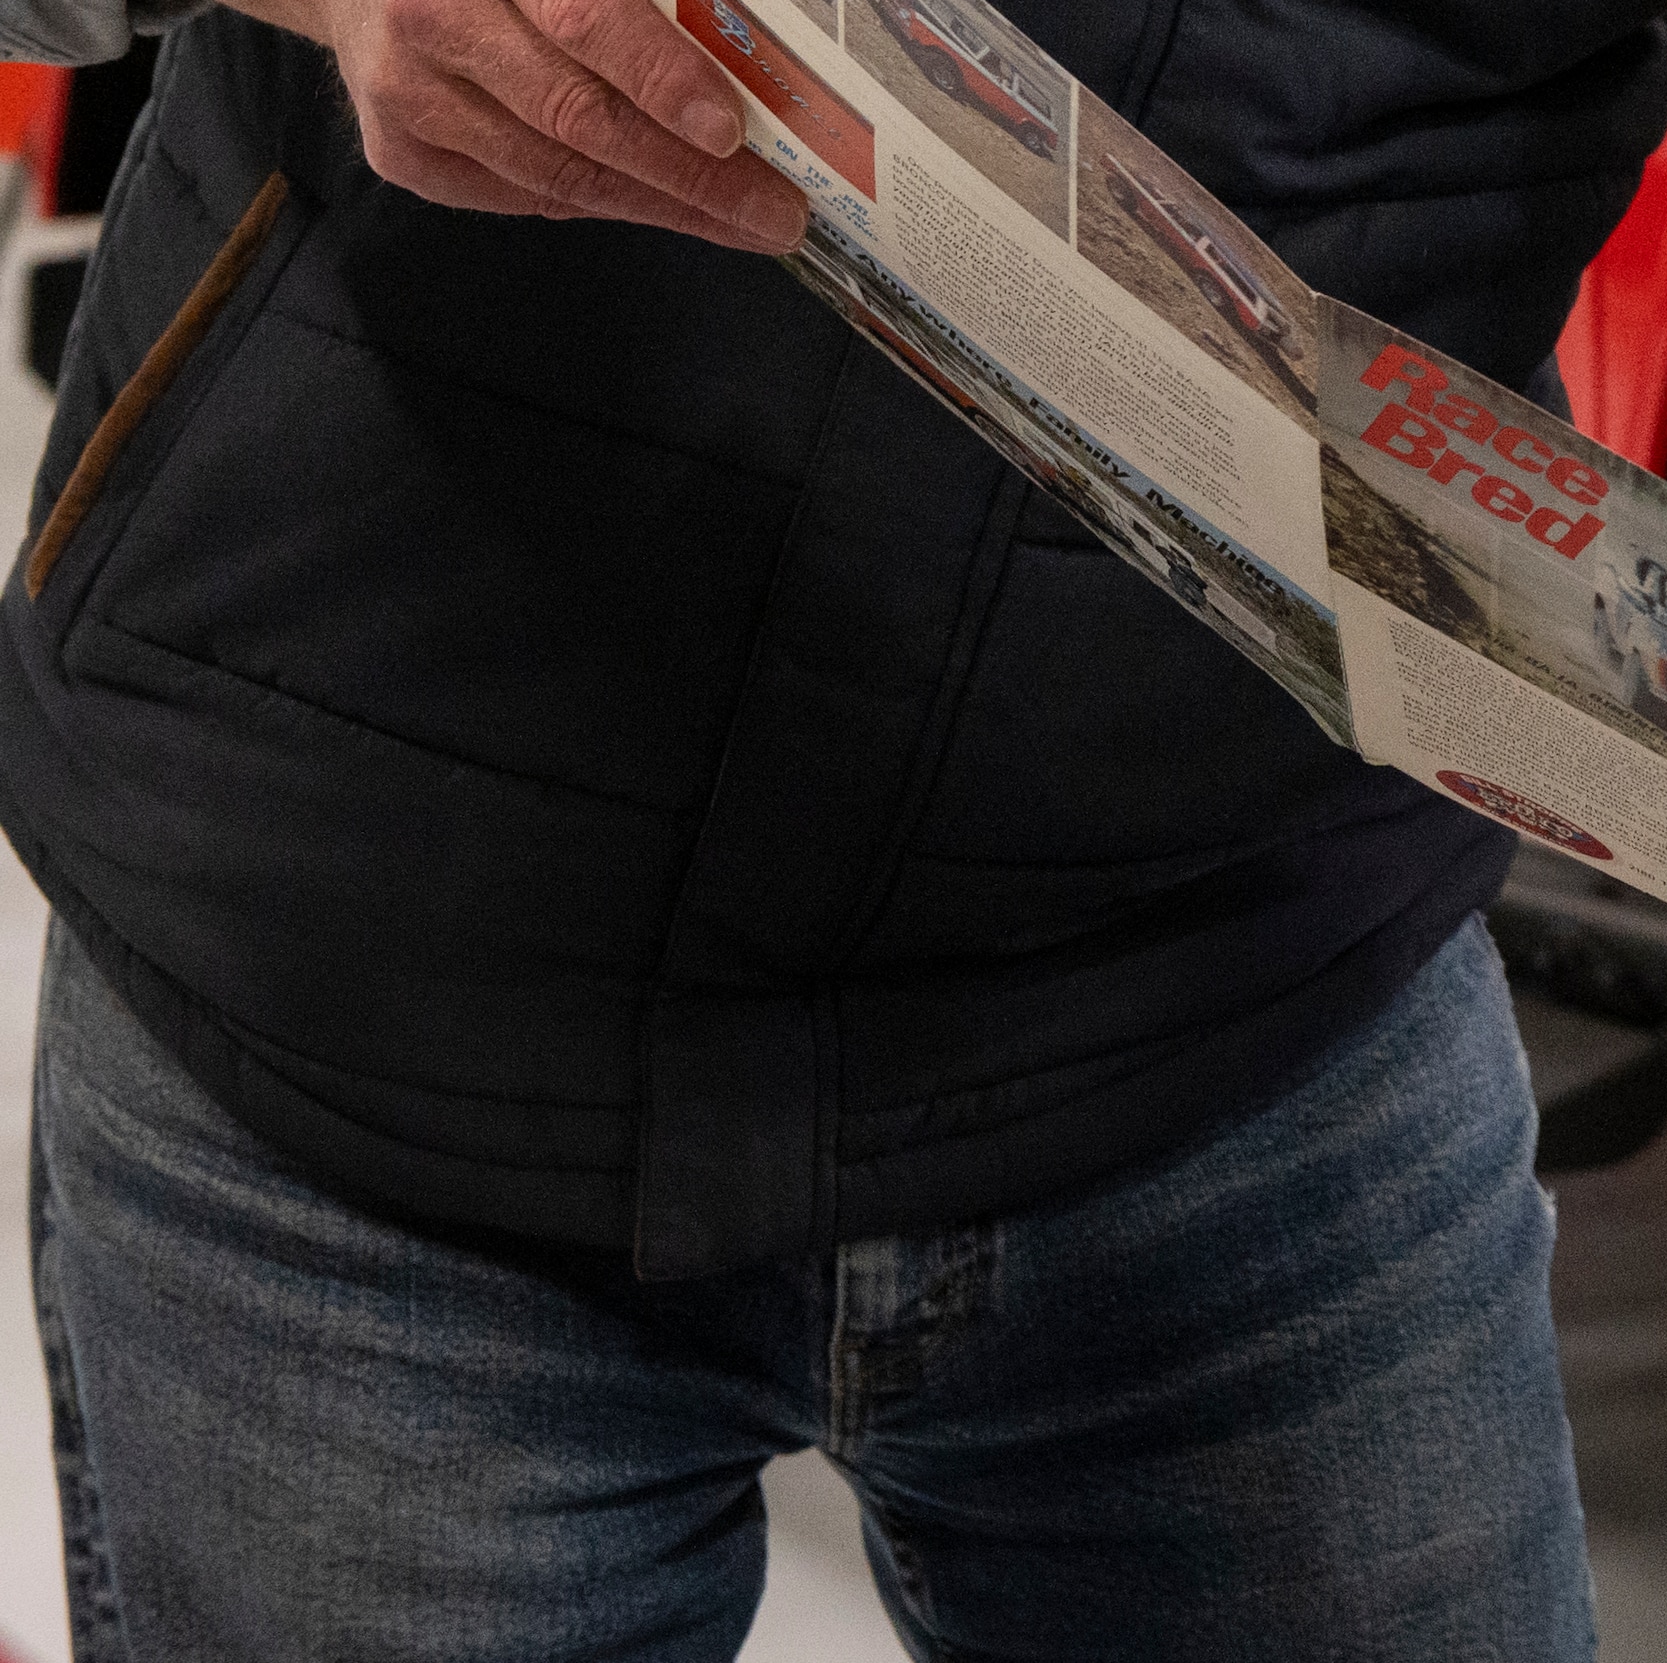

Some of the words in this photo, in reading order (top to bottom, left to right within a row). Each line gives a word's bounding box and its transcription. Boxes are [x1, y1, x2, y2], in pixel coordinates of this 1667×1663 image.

[775, 139, 798, 161] ON
[806, 165, 835, 189] THE
[1029, 397, 1130, 478] Family
[1146, 488, 1285, 597] Machine
[1360, 343, 1609, 507] Race
[1360, 402, 1606, 561] Bred
